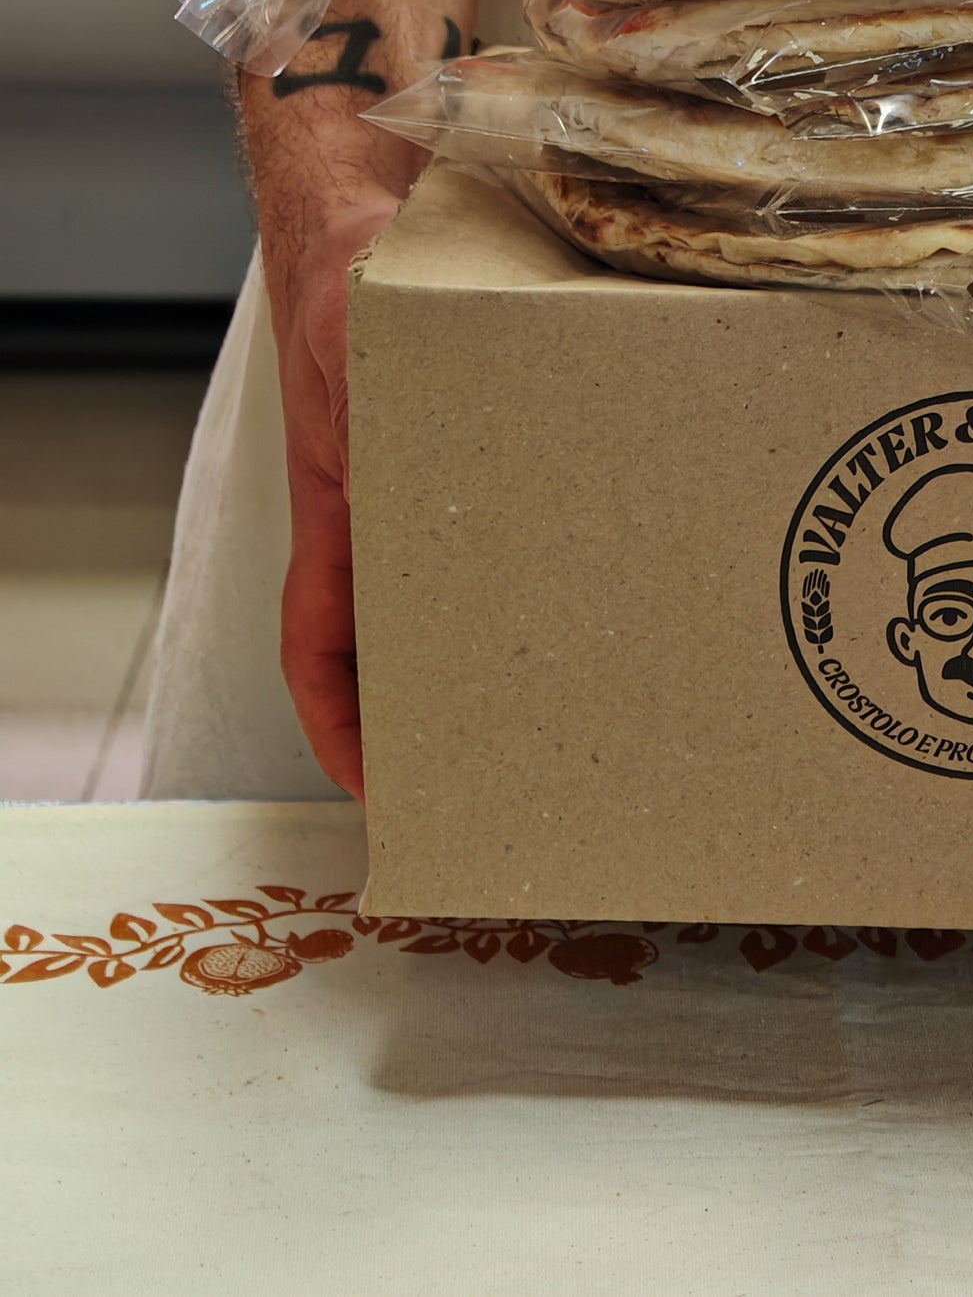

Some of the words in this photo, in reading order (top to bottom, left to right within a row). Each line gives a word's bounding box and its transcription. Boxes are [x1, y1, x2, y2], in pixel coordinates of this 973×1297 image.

[799, 411, 949, 566] VALTER
[818, 657, 918, 746] CROSTOLO
[916, 733, 939, 754] E
